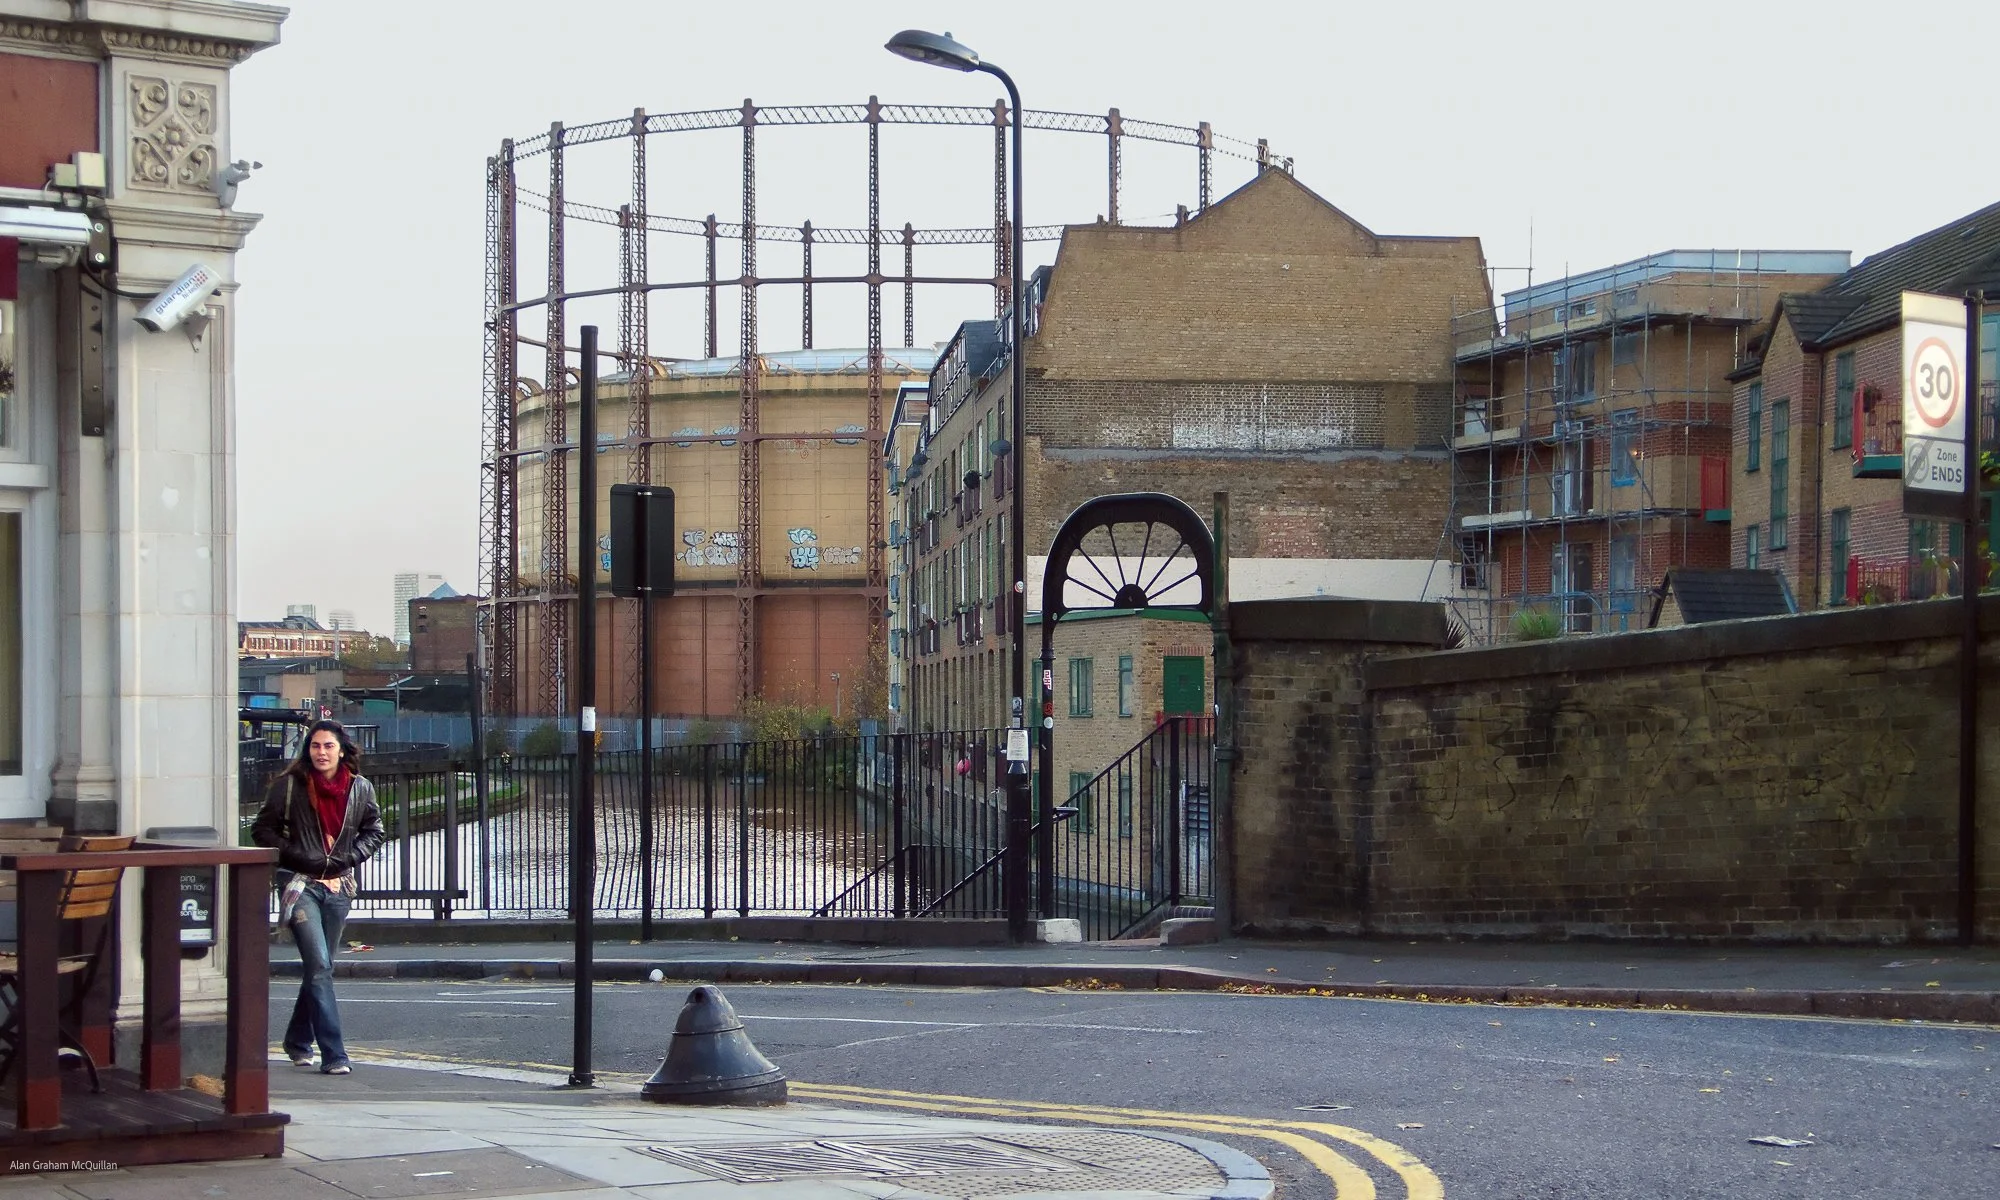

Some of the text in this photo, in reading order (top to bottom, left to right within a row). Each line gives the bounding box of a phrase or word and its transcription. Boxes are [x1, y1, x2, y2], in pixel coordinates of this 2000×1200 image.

[155, 276, 195, 315] guardian
[1919, 362, 1952, 401] 30
[1937, 448, 1957, 462] Zone
[1931, 465, 1962, 483] ENDS
[193, 884, 206, 892] tidy
